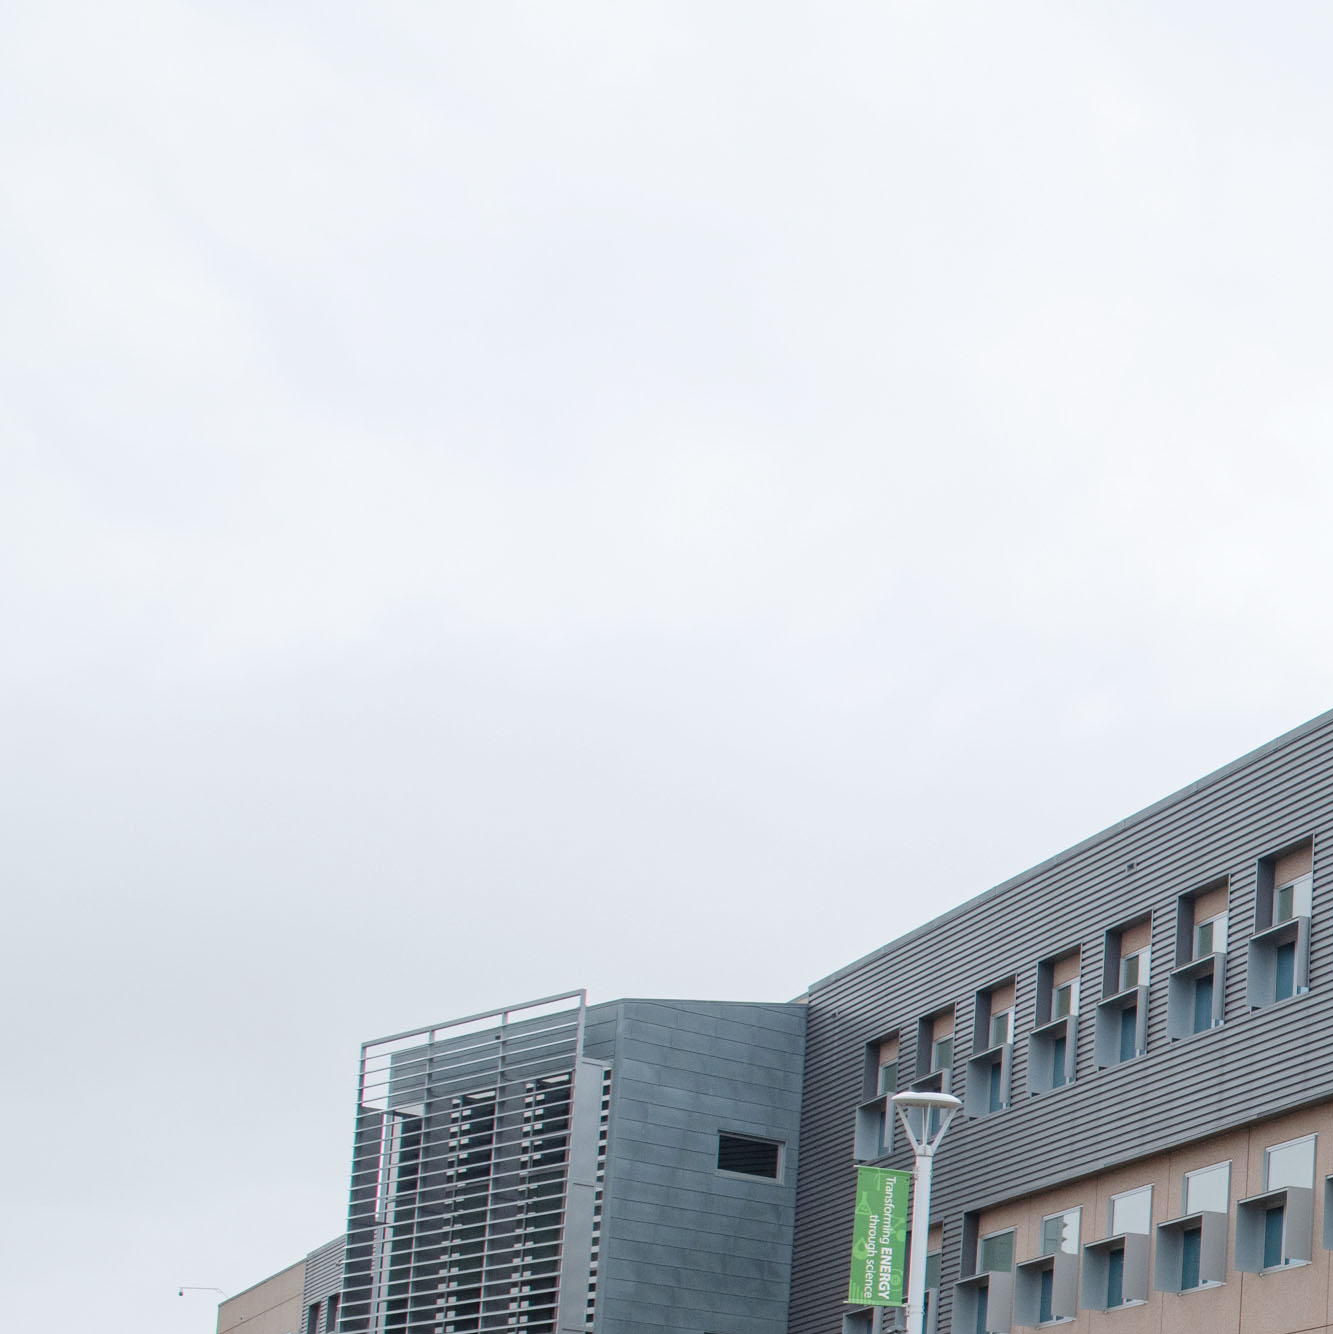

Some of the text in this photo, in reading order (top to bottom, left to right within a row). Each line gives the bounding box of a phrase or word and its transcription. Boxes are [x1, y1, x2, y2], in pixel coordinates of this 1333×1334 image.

[863, 1214, 880, 1298] through science
[878, 1176, 897, 1299] Transforming ENERGY
